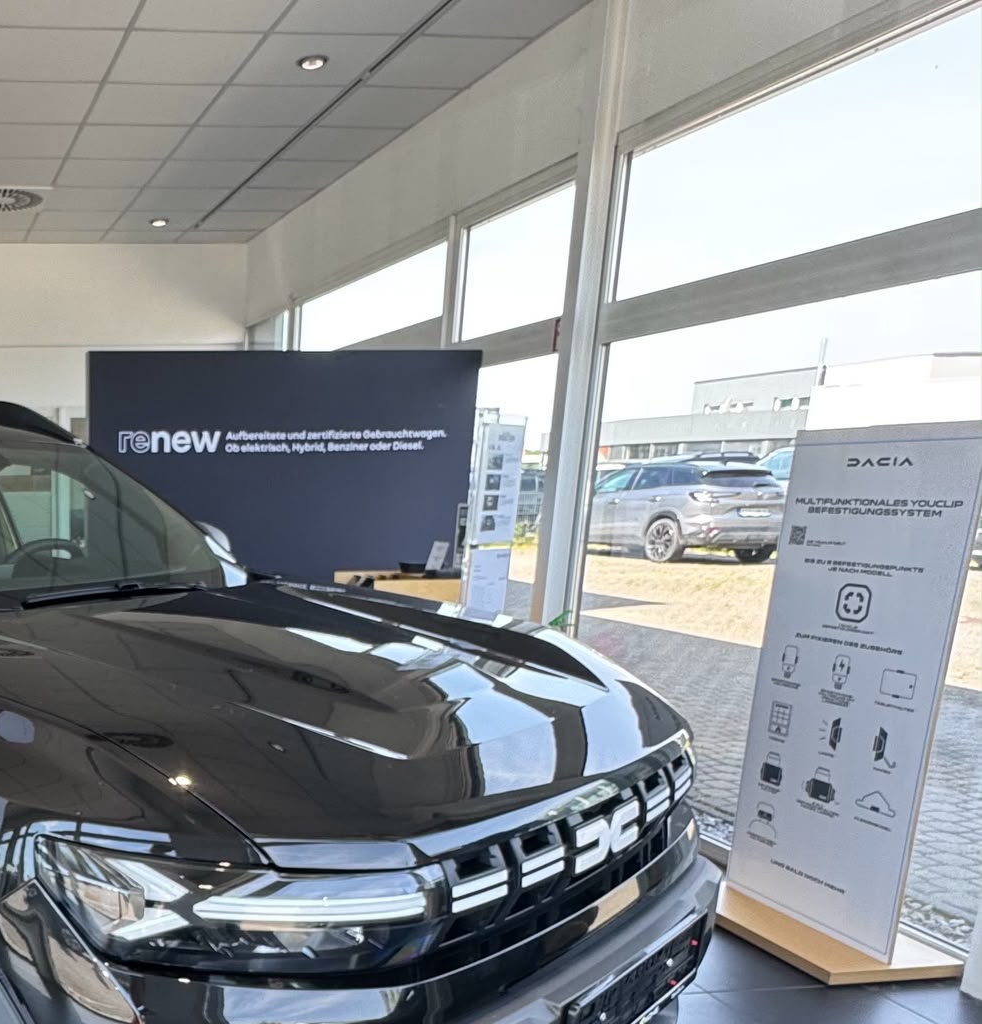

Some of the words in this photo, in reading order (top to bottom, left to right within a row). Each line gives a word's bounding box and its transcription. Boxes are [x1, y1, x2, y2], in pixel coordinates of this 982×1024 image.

[287, 430, 306, 440] und
[117, 429, 222, 454] renew
[224, 443, 239, 452] Ob
[327, 441, 368, 452] Benziner
[369, 441, 391, 451] oder
[846, 456, 914, 468] DACIA
[795, 496, 908, 508] MULTIFUNKTIONALES
[910, 498, 964, 509] YOUCLIP
[807, 506, 943, 518] BEFESTIGUNGSSYSTEM
